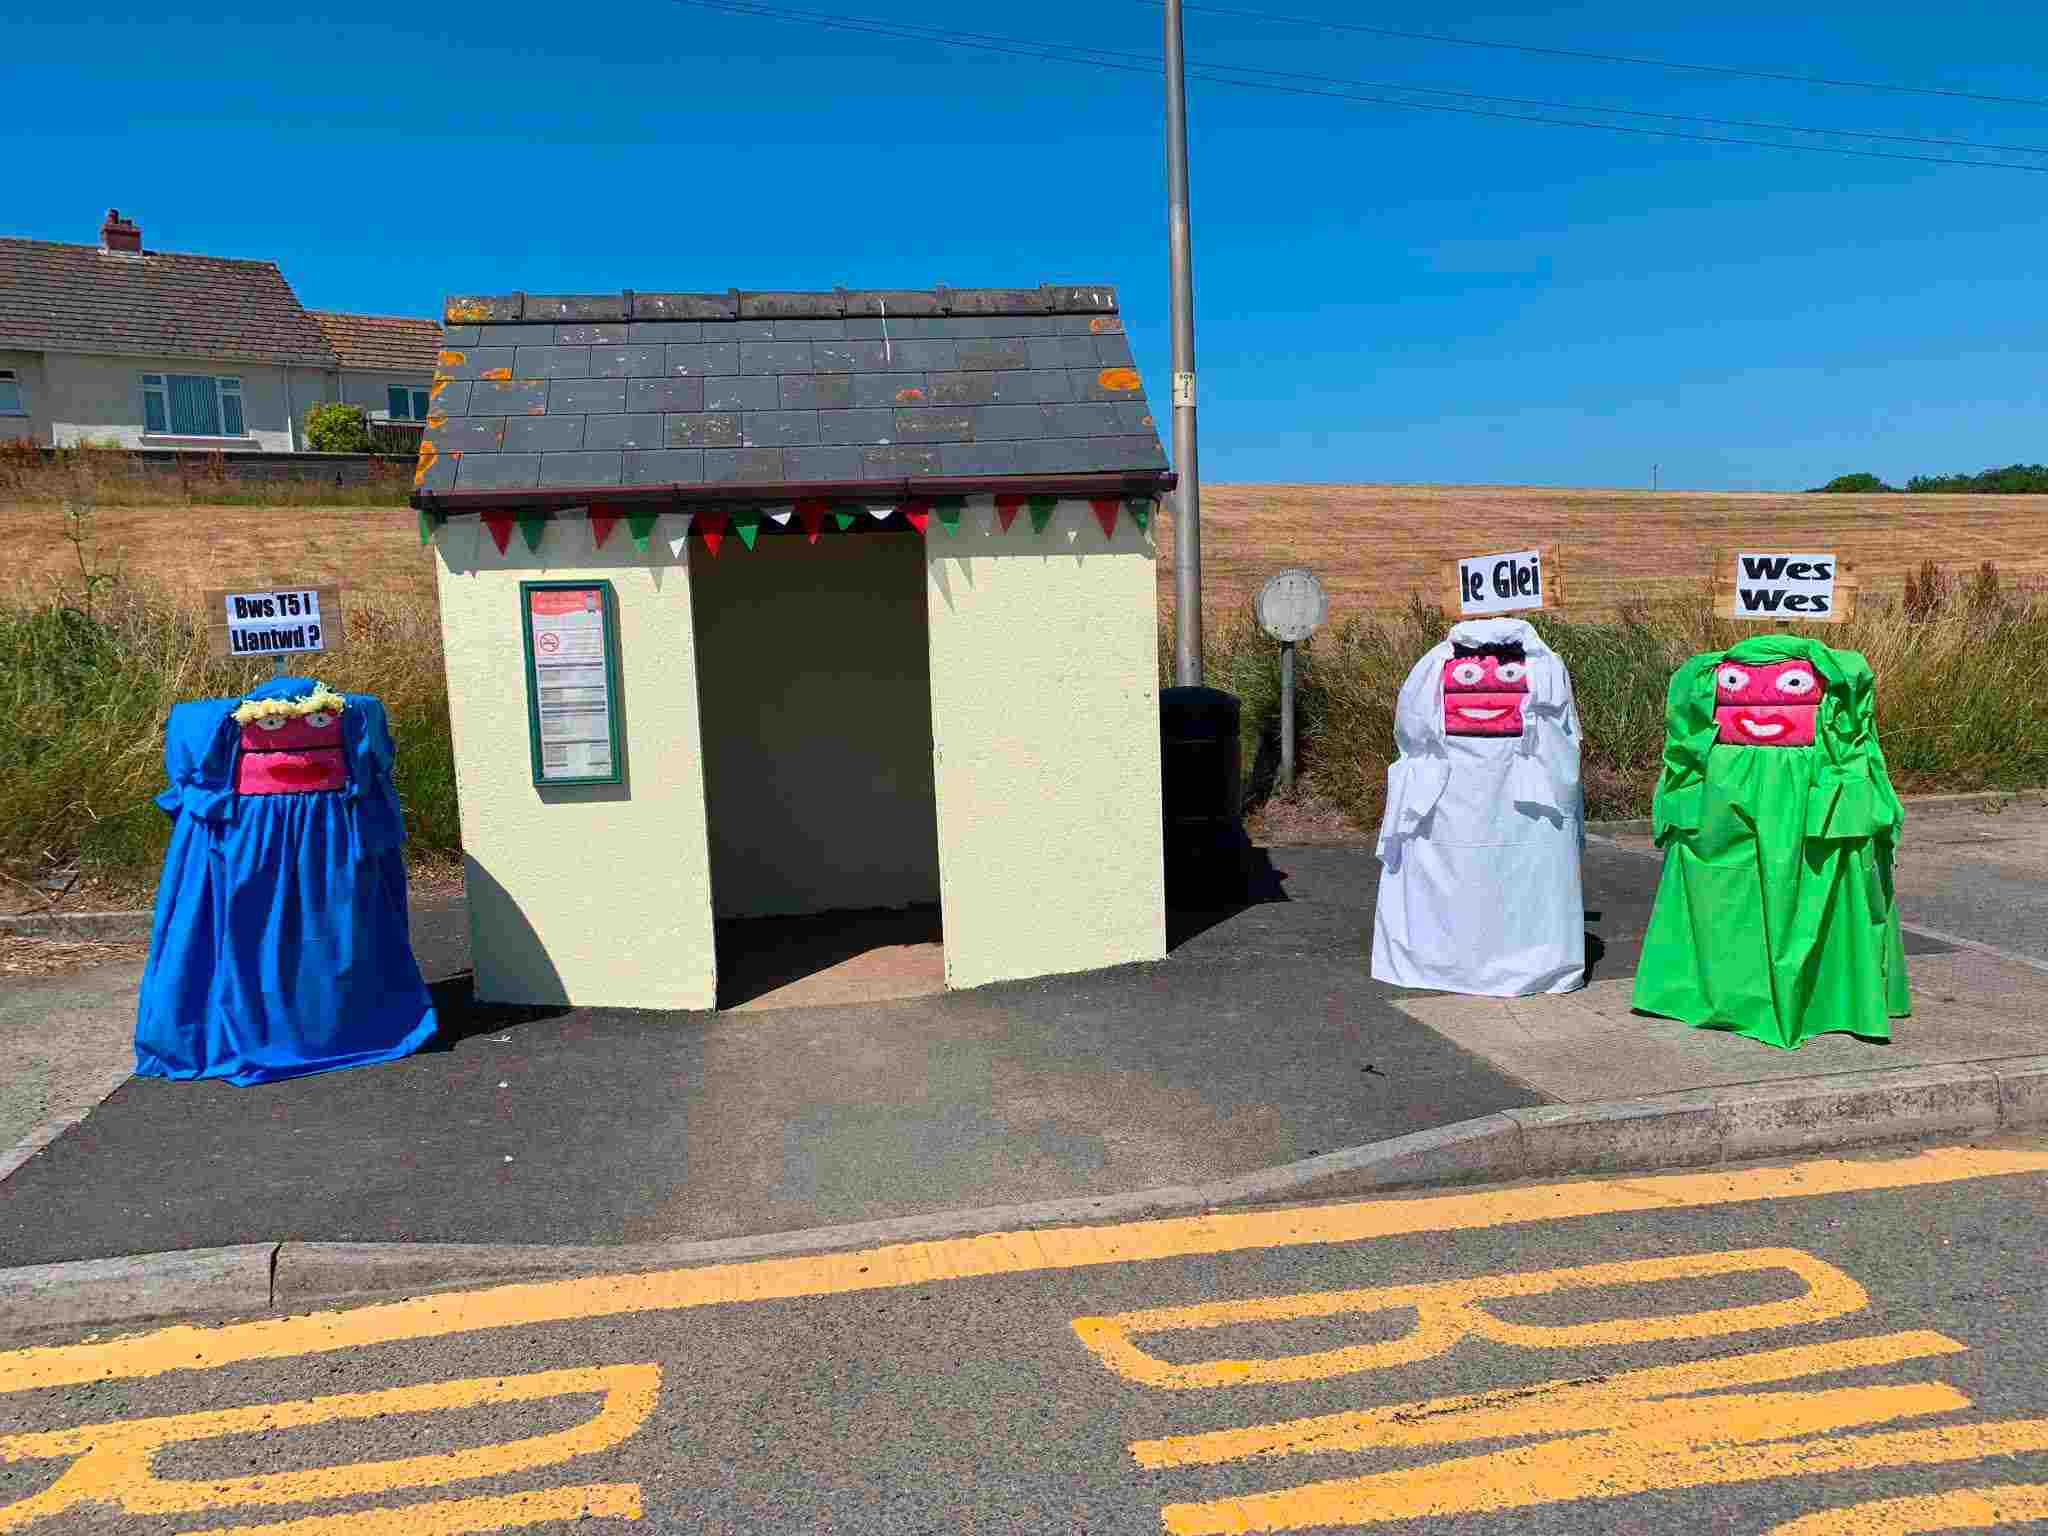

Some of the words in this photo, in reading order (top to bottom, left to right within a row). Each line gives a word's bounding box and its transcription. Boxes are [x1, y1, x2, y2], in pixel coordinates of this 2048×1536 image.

[1493, 557, 1540, 598] Glei
[1742, 558, 1832, 580] Wes
[234, 596, 274, 618] Bws
[277, 594, 300, 616] T5
[1740, 589, 1829, 612] Wes
[232, 626, 305, 651] Llantwd
